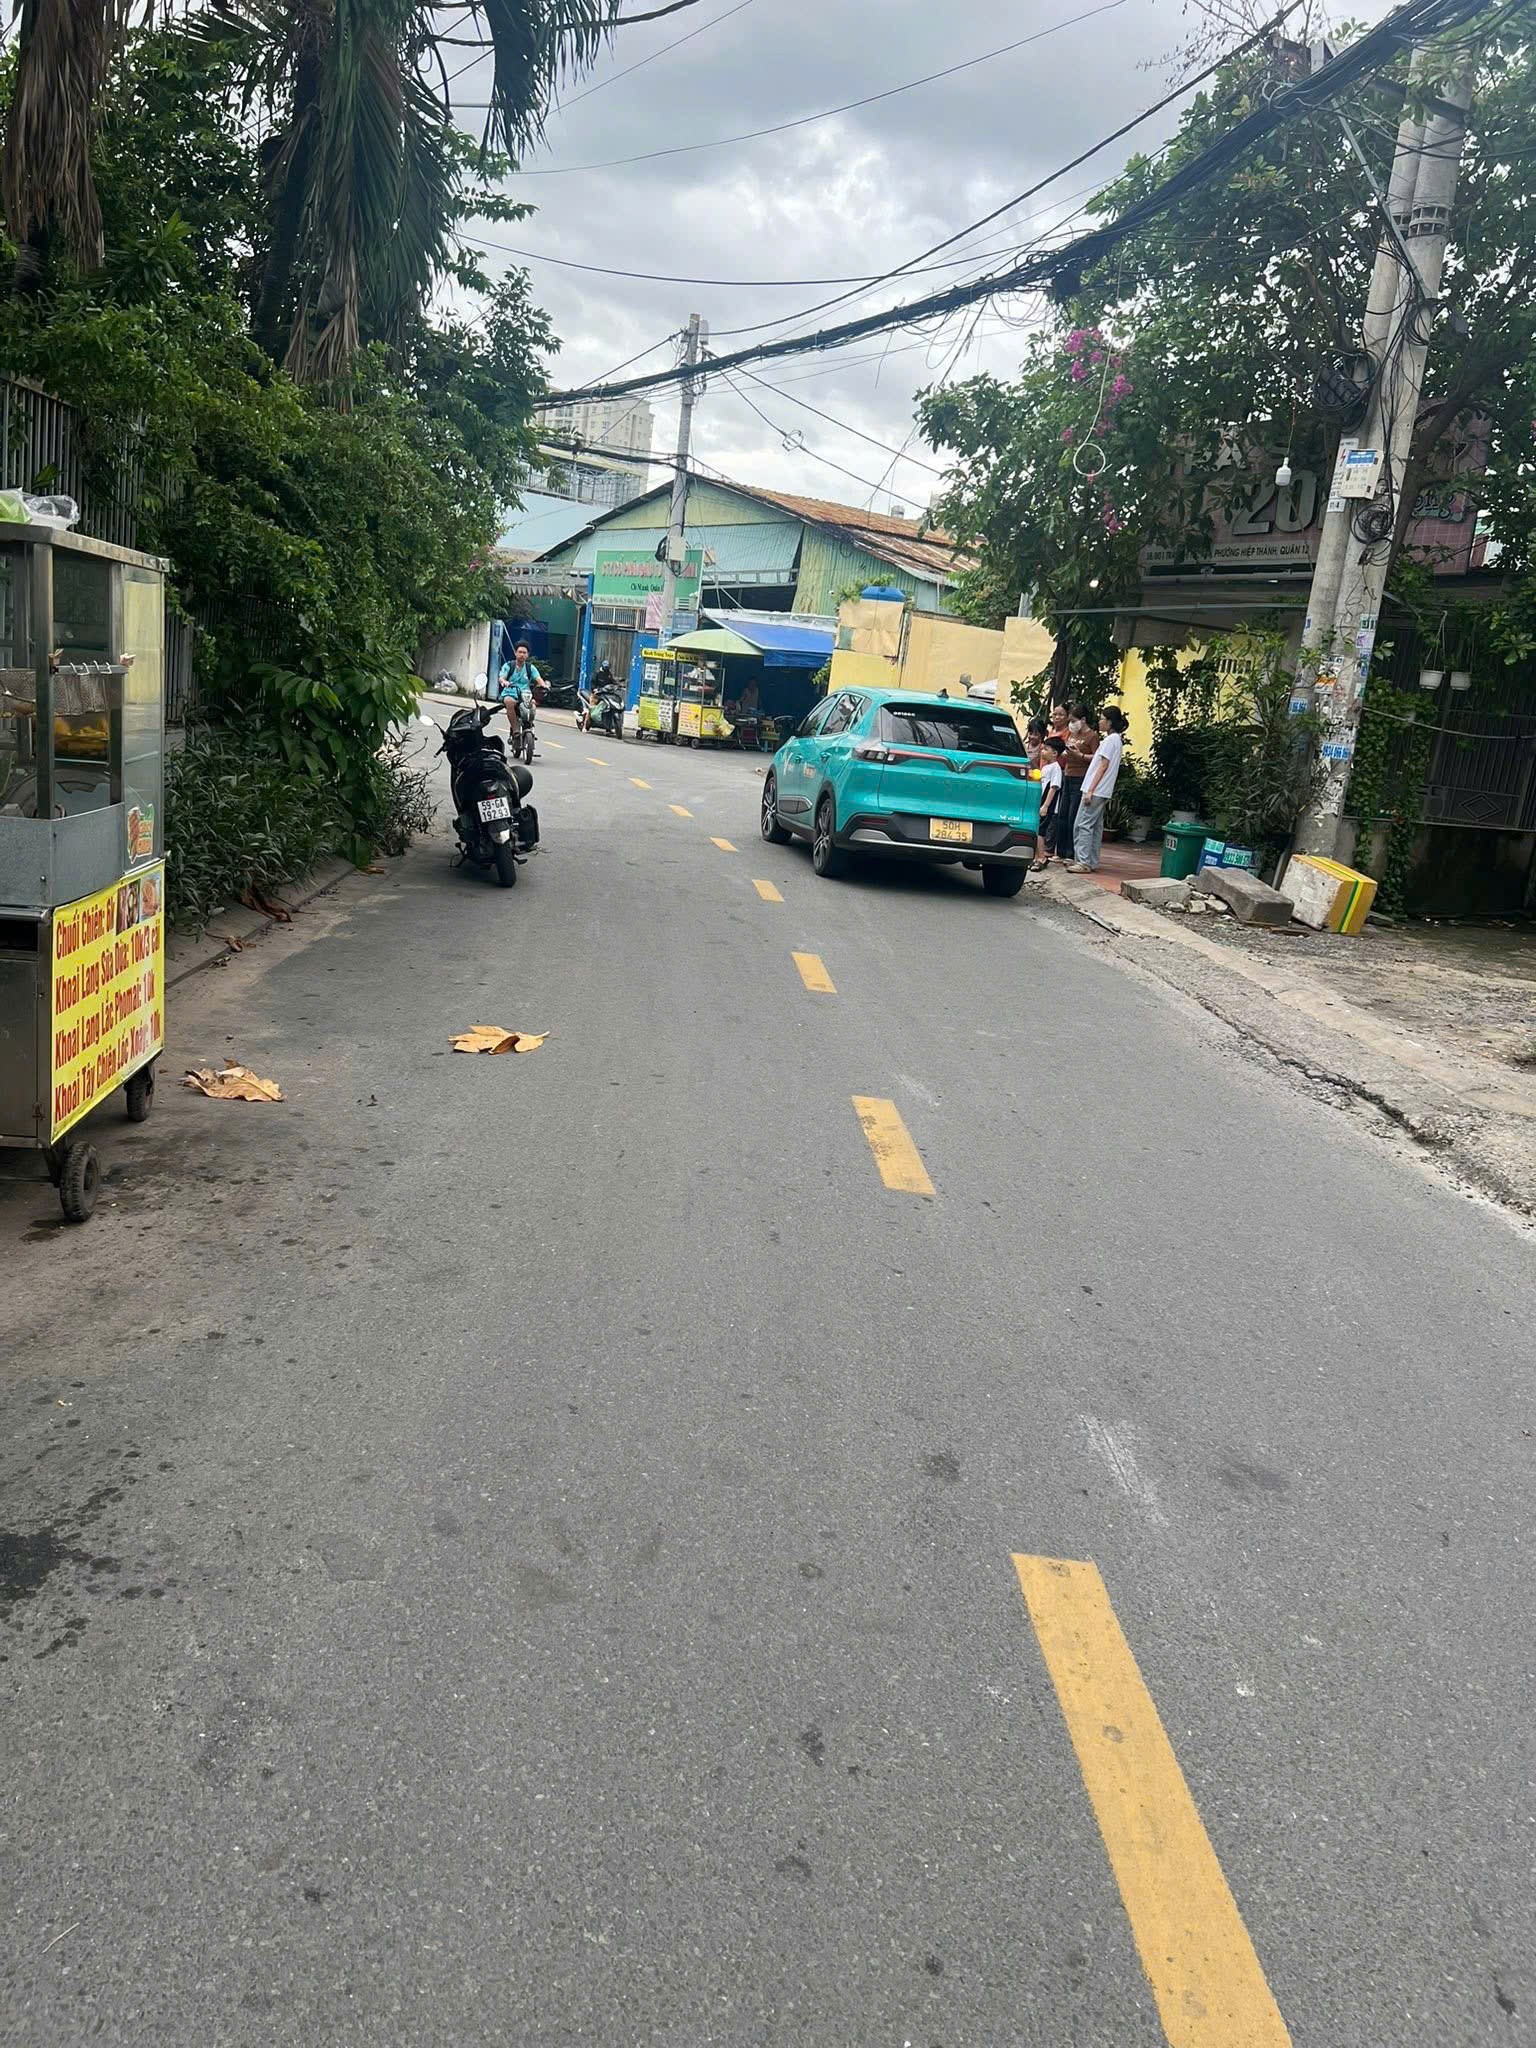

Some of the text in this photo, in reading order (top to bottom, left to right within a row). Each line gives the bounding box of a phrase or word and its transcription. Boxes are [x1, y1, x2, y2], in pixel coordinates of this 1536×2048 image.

[943, 820, 960, 831] 50H
[56, 908, 79, 960] Chuối
[56, 966, 79, 1015] Khoai
[82, 962, 99, 1000] Lang
[56, 1017, 79, 1070] Khoai
[82, 1015, 99, 1051] Lang
[55, 1071, 79, 1124] Khoai
[82, 1062, 95, 1102] Tây
[97, 1044, 116, 1089] Chiên
